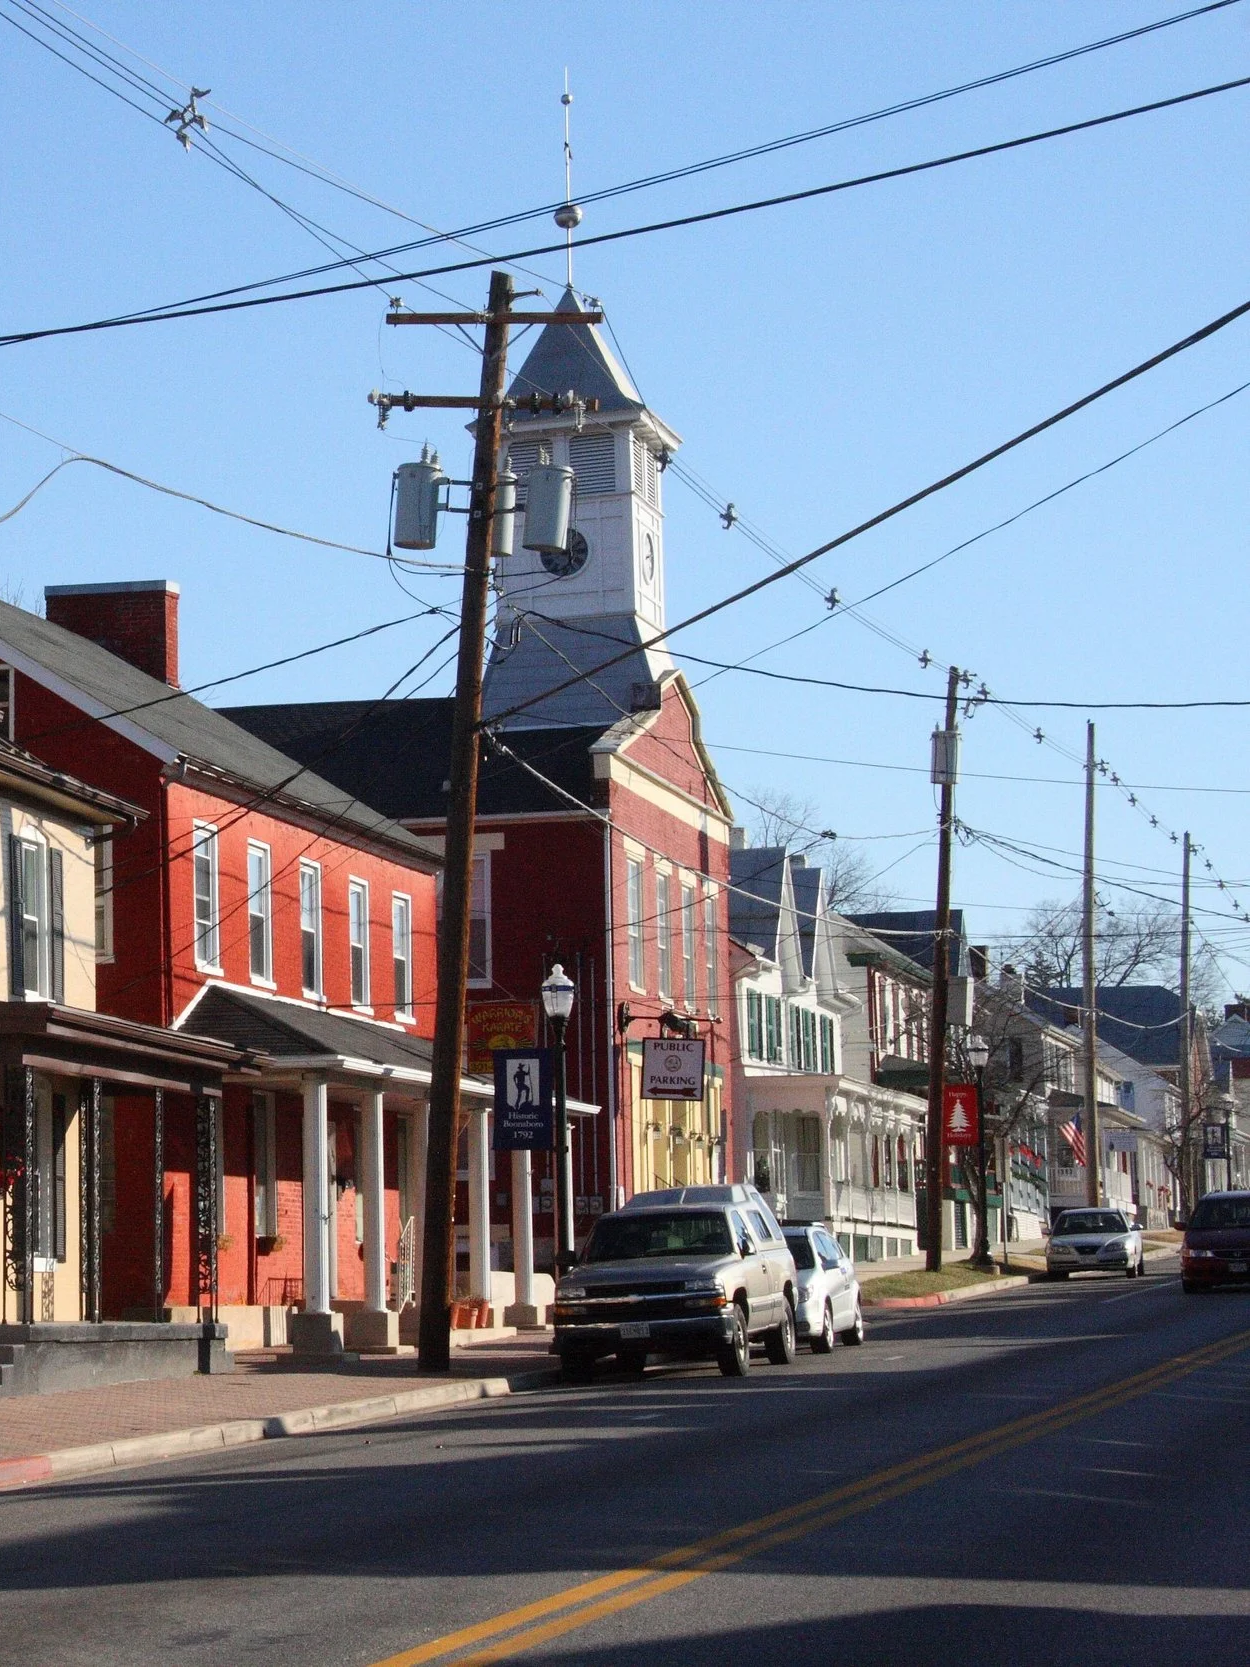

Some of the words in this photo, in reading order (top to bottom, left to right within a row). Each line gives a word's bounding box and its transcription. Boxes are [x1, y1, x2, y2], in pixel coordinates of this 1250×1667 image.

[482, 1022, 523, 1033] KARATE
[653, 1042, 695, 1053] PUBLIC
[650, 1075, 696, 1086] PARKING
[948, 1091, 968, 1099] Happy
[508, 1111, 539, 1120] Historic
[503, 1119, 544, 1128] Boonsboro
[513, 1130, 534, 1139] 1792
